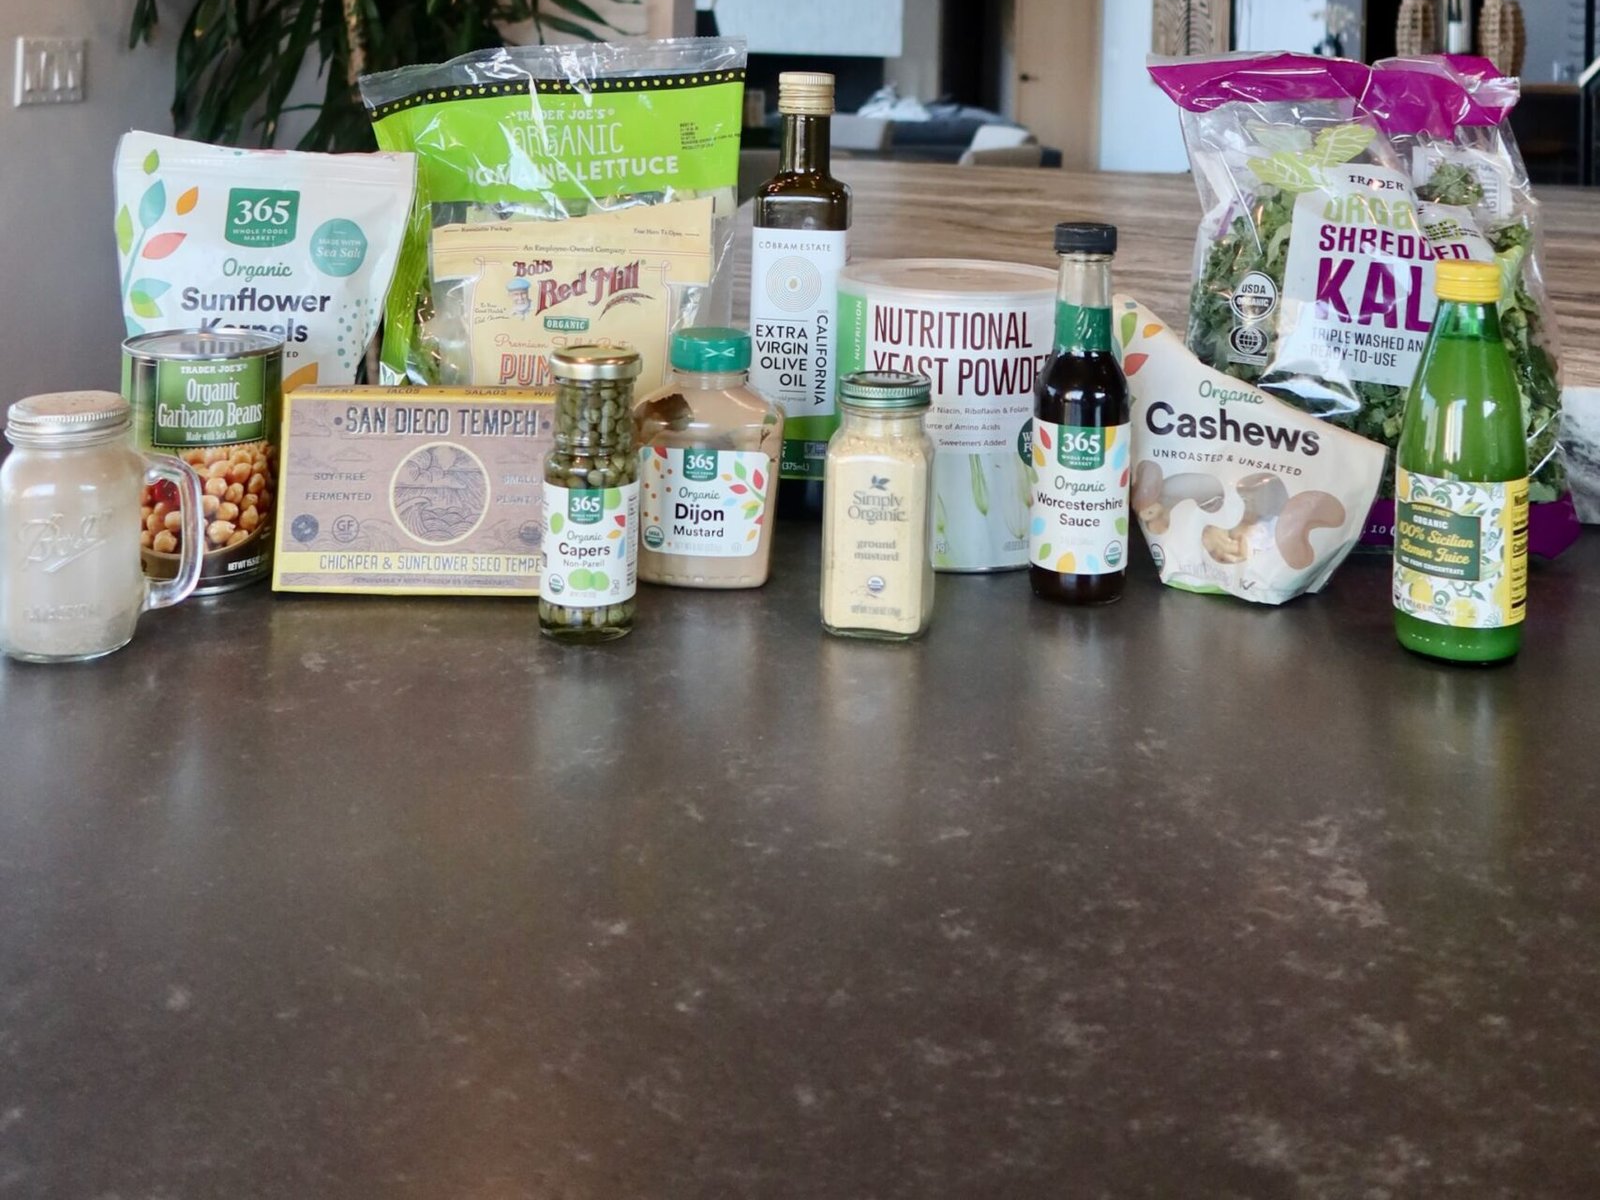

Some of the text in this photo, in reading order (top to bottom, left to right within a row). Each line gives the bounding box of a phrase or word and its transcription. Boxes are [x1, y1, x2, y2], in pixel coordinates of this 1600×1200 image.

[512, 122, 624, 157] ORGANIC
[467, 155, 679, 187] OMNE LETTUCE
[1348, 175, 1405, 191] TRADER
[233, 197, 292, 225] 365
[595, 246, 626, 255] Company
[800, 243, 832, 252] ESTATE
[1319, 223, 1470, 261] SHREDDED
[315, 246, 361, 258] Sea Salt
[222, 257, 293, 283] Organic
[513, 260, 553, 277] Bob's
[535, 269, 588, 316] Red
[1241, 284, 1267, 295] USDA
[1315, 257, 1433, 332] KAL
[180, 286, 331, 313] Sunflower
[201, 317, 308, 343] Kels
[546, 319, 586, 330] ORGANIC
[756, 324, 808, 340] EXTRA
[854, 300, 863, 360] NUTRITION
[874, 304, 1033, 350] NUTRITIONAL
[756, 340, 808, 355] VIRGIN
[1312, 327, 1424, 352] TRIPLE WASHED AN
[760, 356, 808, 372] OLIVE
[814, 314, 829, 406] CALIFORNIA
[180, 366, 216, 374] TRADER
[873, 350, 1052, 397] YEAST POWDE
[780, 373, 807, 388] OIL
[187, 377, 241, 406] Organic
[1198, 379, 1265, 406] Organic
[158, 402, 263, 428] Garbanzo Beans
[964, 407, 1000, 415] Riboflavin
[346, 407, 539, 436] SAN DIEGO TEMPEH
[926, 422, 1000, 431] urce of Amino Acids
[1145, 401, 1320, 456] Cashews
[938, 439, 1007, 447] Sweeteners Added
[1062, 431, 1101, 455] 365
[686, 454, 715, 470] 365
[1152, 449, 1303, 477] UNROASTED & UNSALTED
[679, 486, 720, 501] Organic
[1054, 475, 1106, 495] Organic
[305, 491, 372, 501] FERMENTED
[571, 496, 600, 512] 365
[853, 490, 905, 510] Simply
[1037, 491, 1124, 512] Worcestershire
[675, 503, 725, 525] Dijon
[848, 504, 908, 525] Organic
[1059, 513, 1101, 527] Sauce
[1413, 515, 1449, 530] ORGANIC
[336, 520, 354, 532] GF
[673, 525, 724, 538] Mustard
[567, 530, 602, 544] Organic
[856, 539, 897, 552] ground
[1427, 530, 1475, 549] Sicilian
[558, 542, 611, 560] Capers
[854, 551, 899, 562] mustard
[1401, 538, 1471, 565] Lemon Juice
[320, 555, 542, 573] CHICKPEA & SUNFLOWER SEED TEMPE
[563, 559, 605, 568] Non-Pareil
